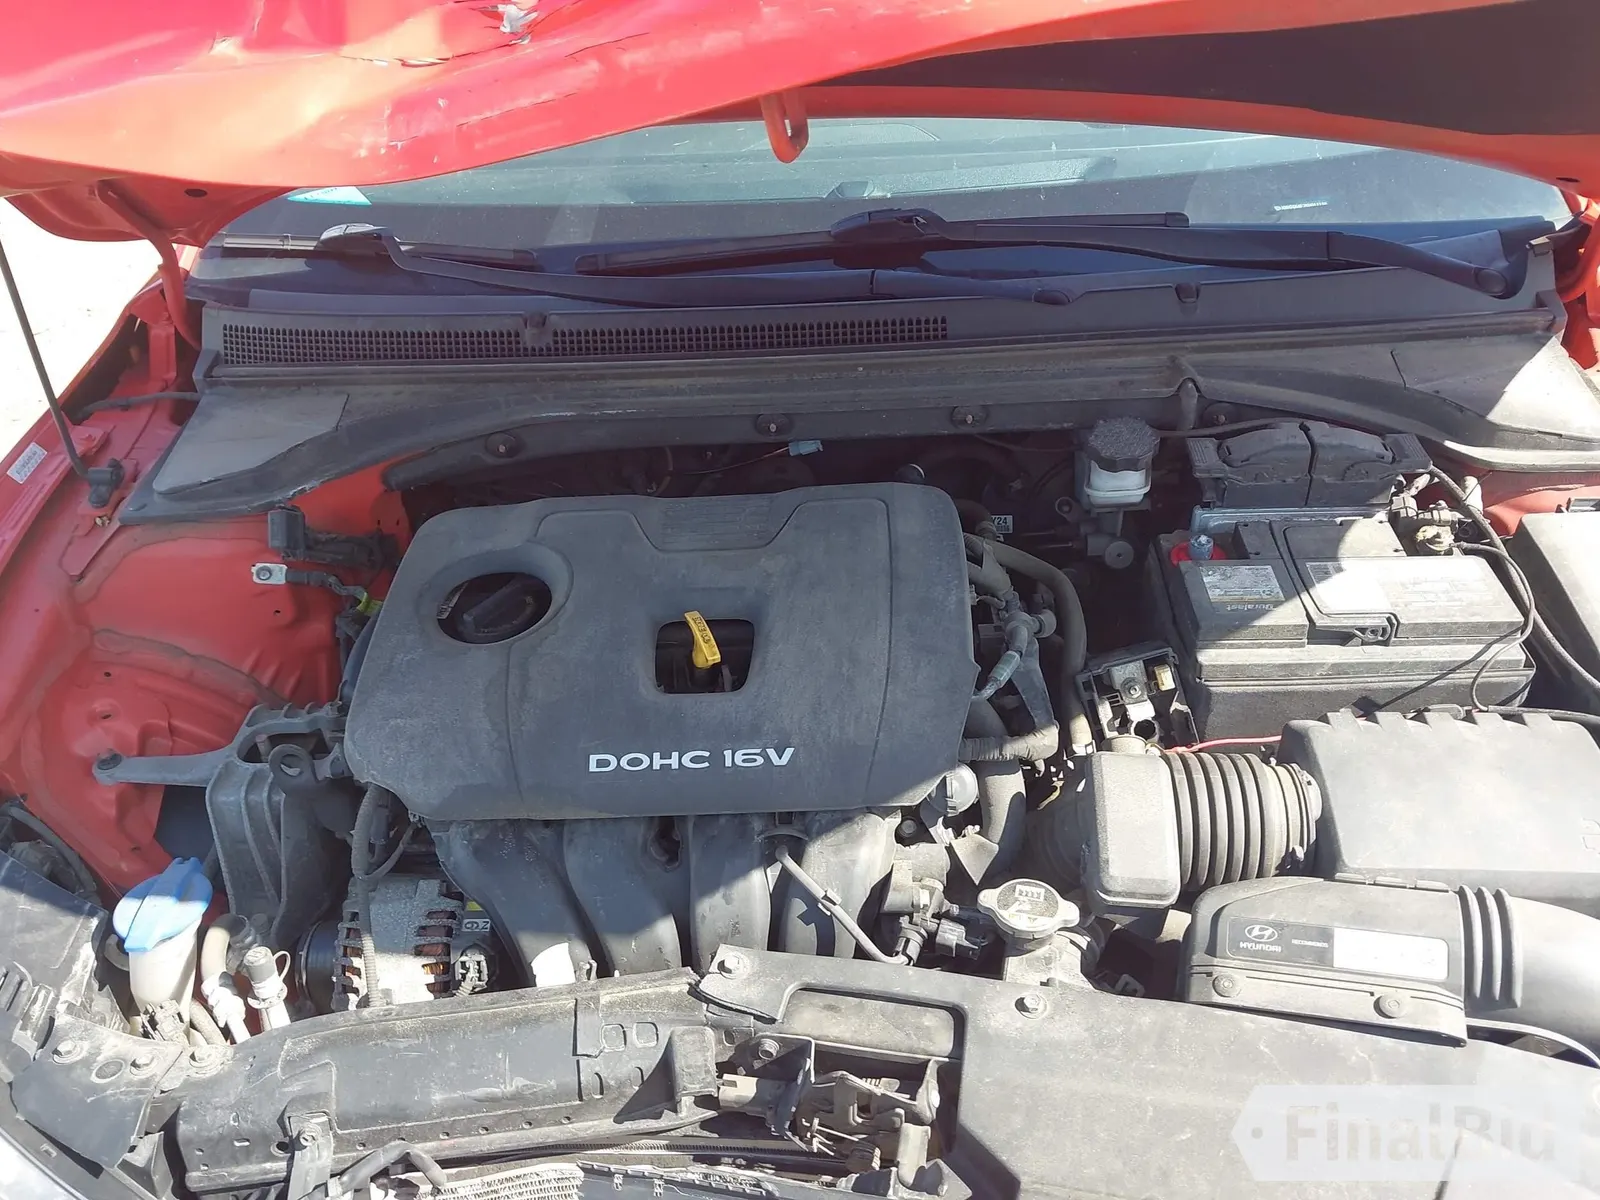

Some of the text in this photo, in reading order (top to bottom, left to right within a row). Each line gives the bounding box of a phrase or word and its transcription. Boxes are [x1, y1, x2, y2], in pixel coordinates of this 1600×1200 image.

[588, 747, 795, 772] DOHC 16V
[1240, 941, 1282, 953] HYUNDAI
